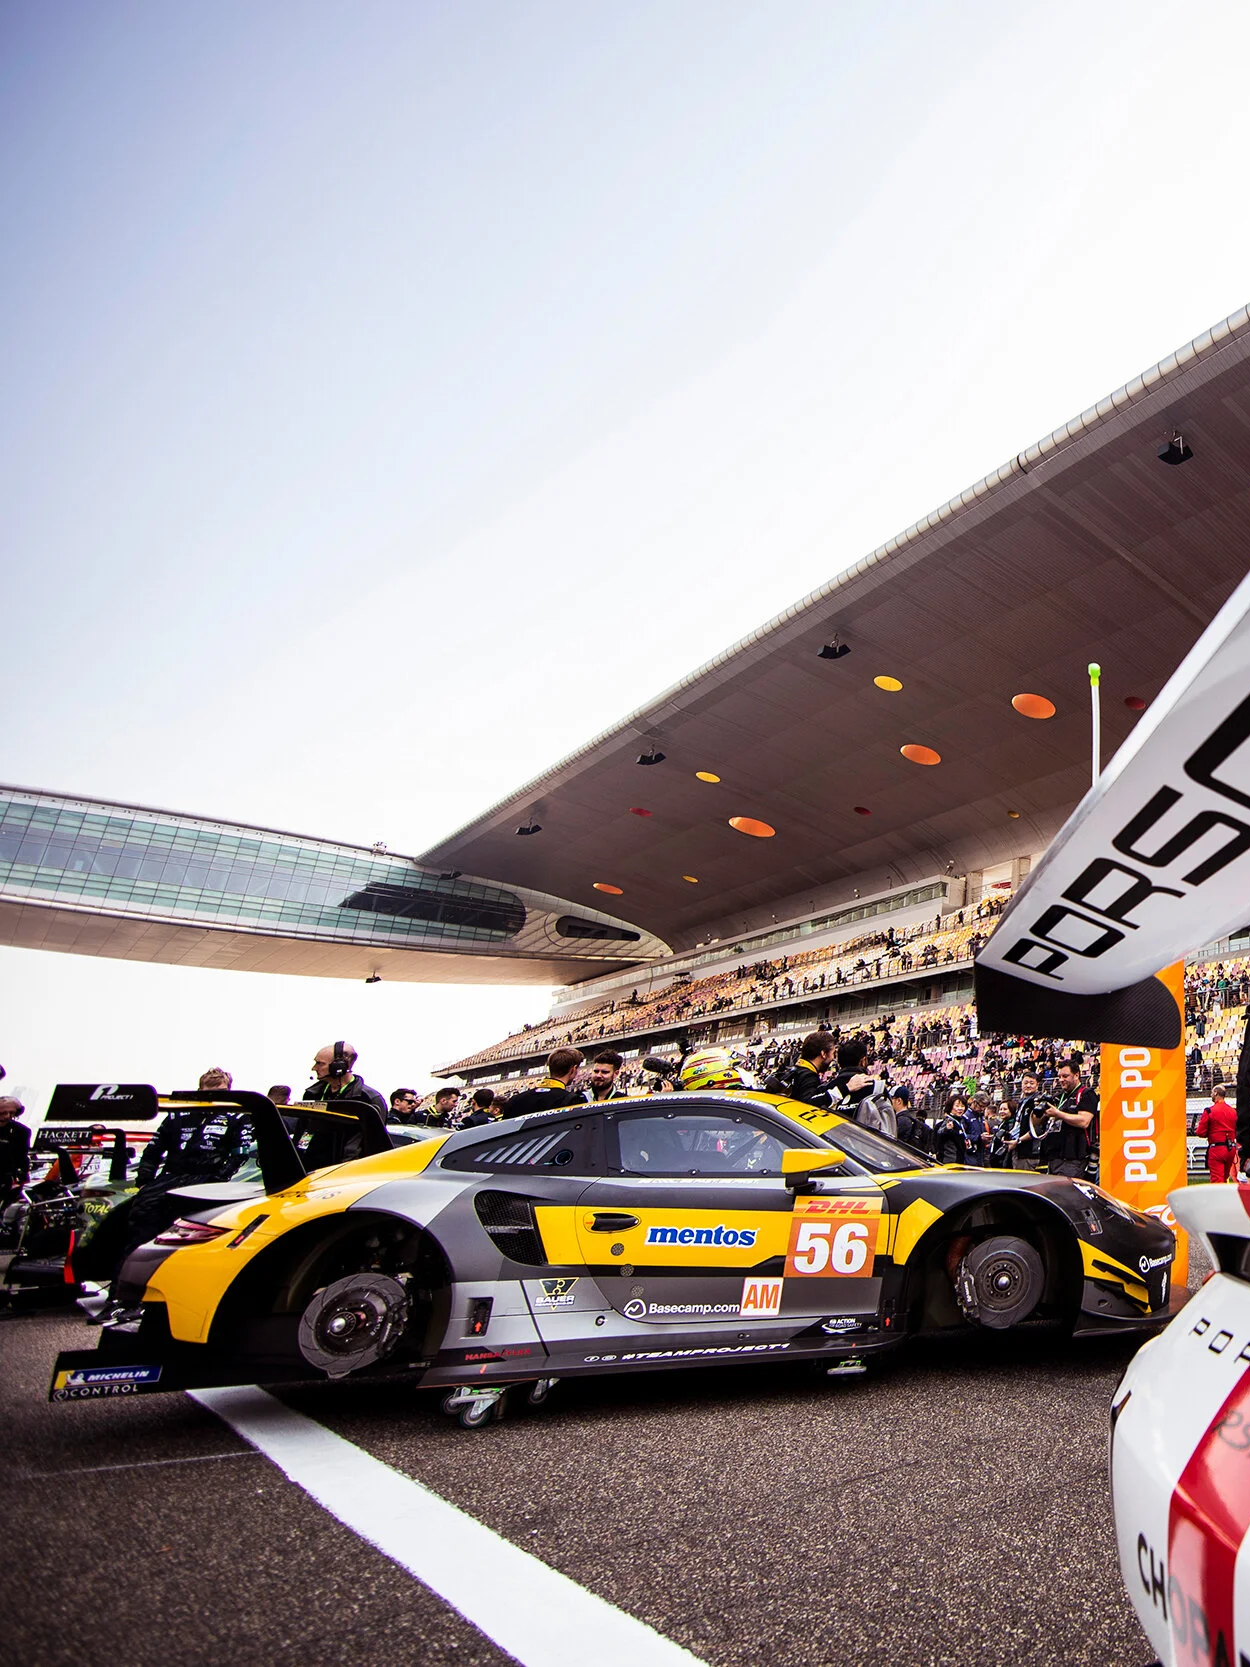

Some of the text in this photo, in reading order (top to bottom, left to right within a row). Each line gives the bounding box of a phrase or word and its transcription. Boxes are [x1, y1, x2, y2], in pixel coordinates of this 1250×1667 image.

[38, 1131, 92, 1139] HACKETT
[1121, 1099, 1157, 1182] POLE
[84, 1202, 110, 1214] TOTAL
[805, 1200, 872, 1214] DHL
[647, 1225, 757, 1246] mentos
[793, 1222, 869, 1274] 56
[743, 1284, 779, 1309] AM
[649, 1303, 740, 1315] Basecamp.com
[622, 1342, 790, 1361] #TEAMPROJECT1
[87, 1371, 150, 1382] MICHELIN
[70, 1384, 139, 1397] CONTROL
